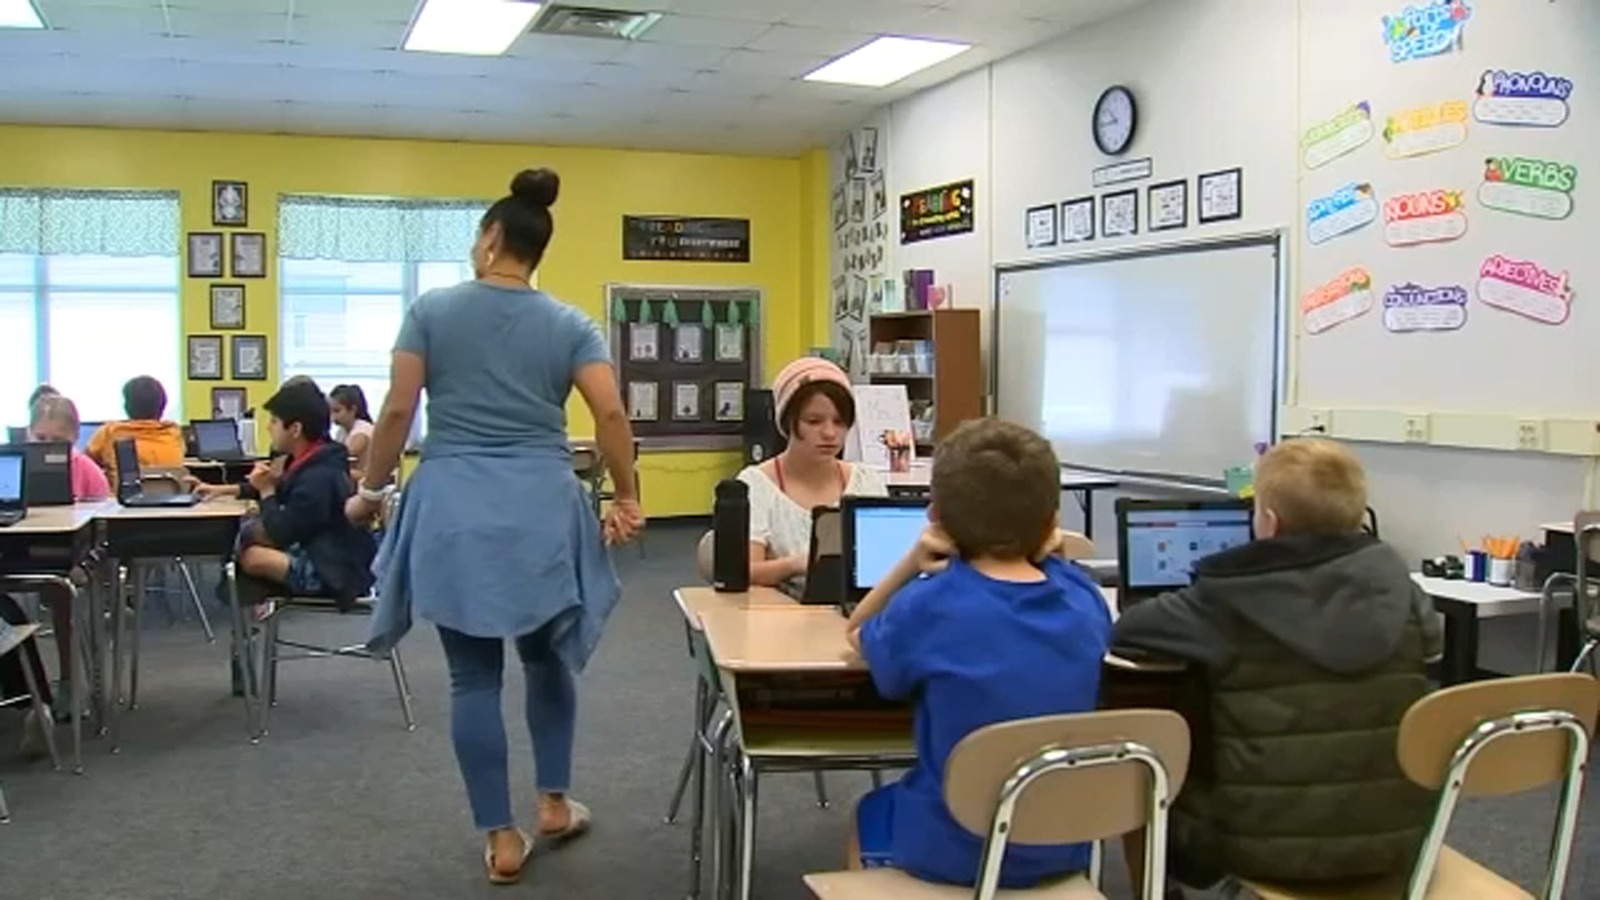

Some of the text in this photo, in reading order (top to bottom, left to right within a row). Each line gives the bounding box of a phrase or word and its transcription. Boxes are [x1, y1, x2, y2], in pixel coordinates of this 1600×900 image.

[1390, 31, 1456, 62] SPEEC
[1494, 71, 1573, 99] PRONOUNS
[1502, 158, 1576, 191] VERBS
[1385, 191, 1447, 221] NOUNS
[1480, 256, 1563, 293] ADJECTIVES
